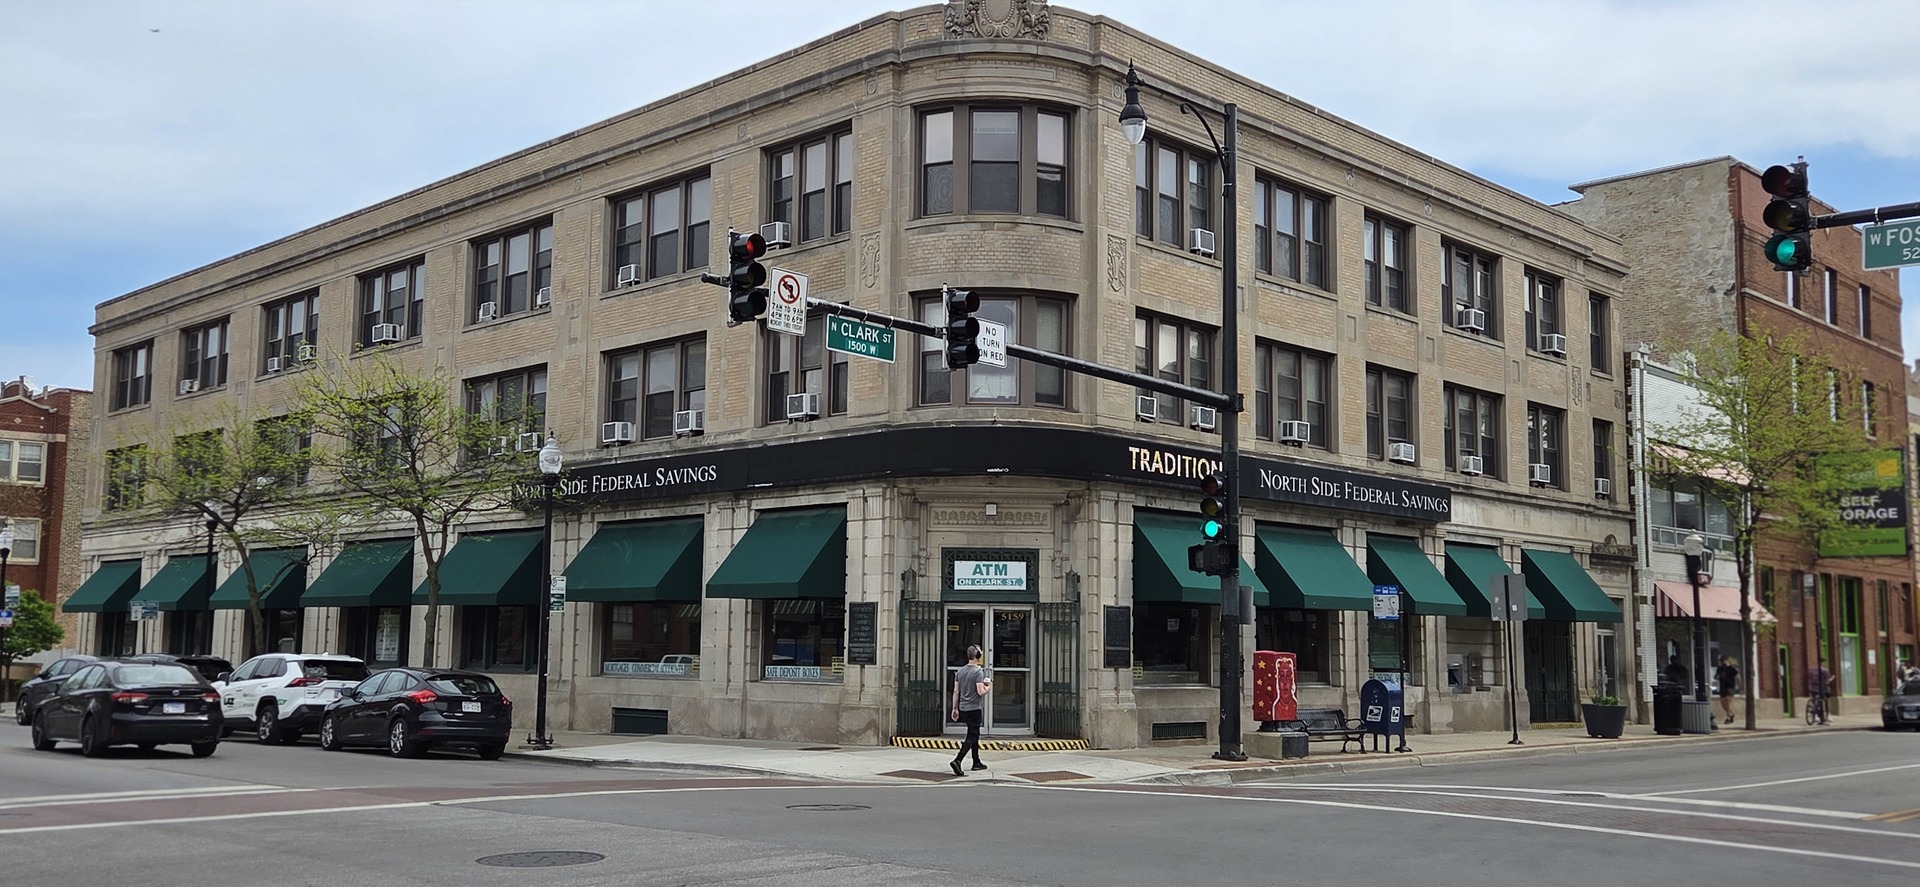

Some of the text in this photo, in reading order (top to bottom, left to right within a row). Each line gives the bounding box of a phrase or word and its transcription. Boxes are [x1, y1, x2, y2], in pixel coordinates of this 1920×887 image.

[1870, 233, 1881, 245] W
[784, 305, 791, 313] TO
[784, 313, 790, 321] TO
[831, 321, 892, 344] N CLARK ST
[985, 326, 997, 336] NO
[847, 339, 877, 354] 1500 W
[982, 337, 1000, 349] TURN
[979, 348, 1003, 362] ON RED
[515, 465, 717, 499] NORT SIDE FEDERAL SAVINGS
[1259, 469, 1449, 513] NORTH SIDE FEDERAL SAVINGS
[1840, 495, 1880, 508] SELF
[1834, 507, 1899, 520] TORAGE
[972, 563, 1008, 576] ATM
[958, 578, 972, 586] ON
[974, 578, 1004, 586] CLARK
[1001, 612, 1024, 621] 5159
[766, 666, 819, 678] SAFE DEPOSIT BOXES
